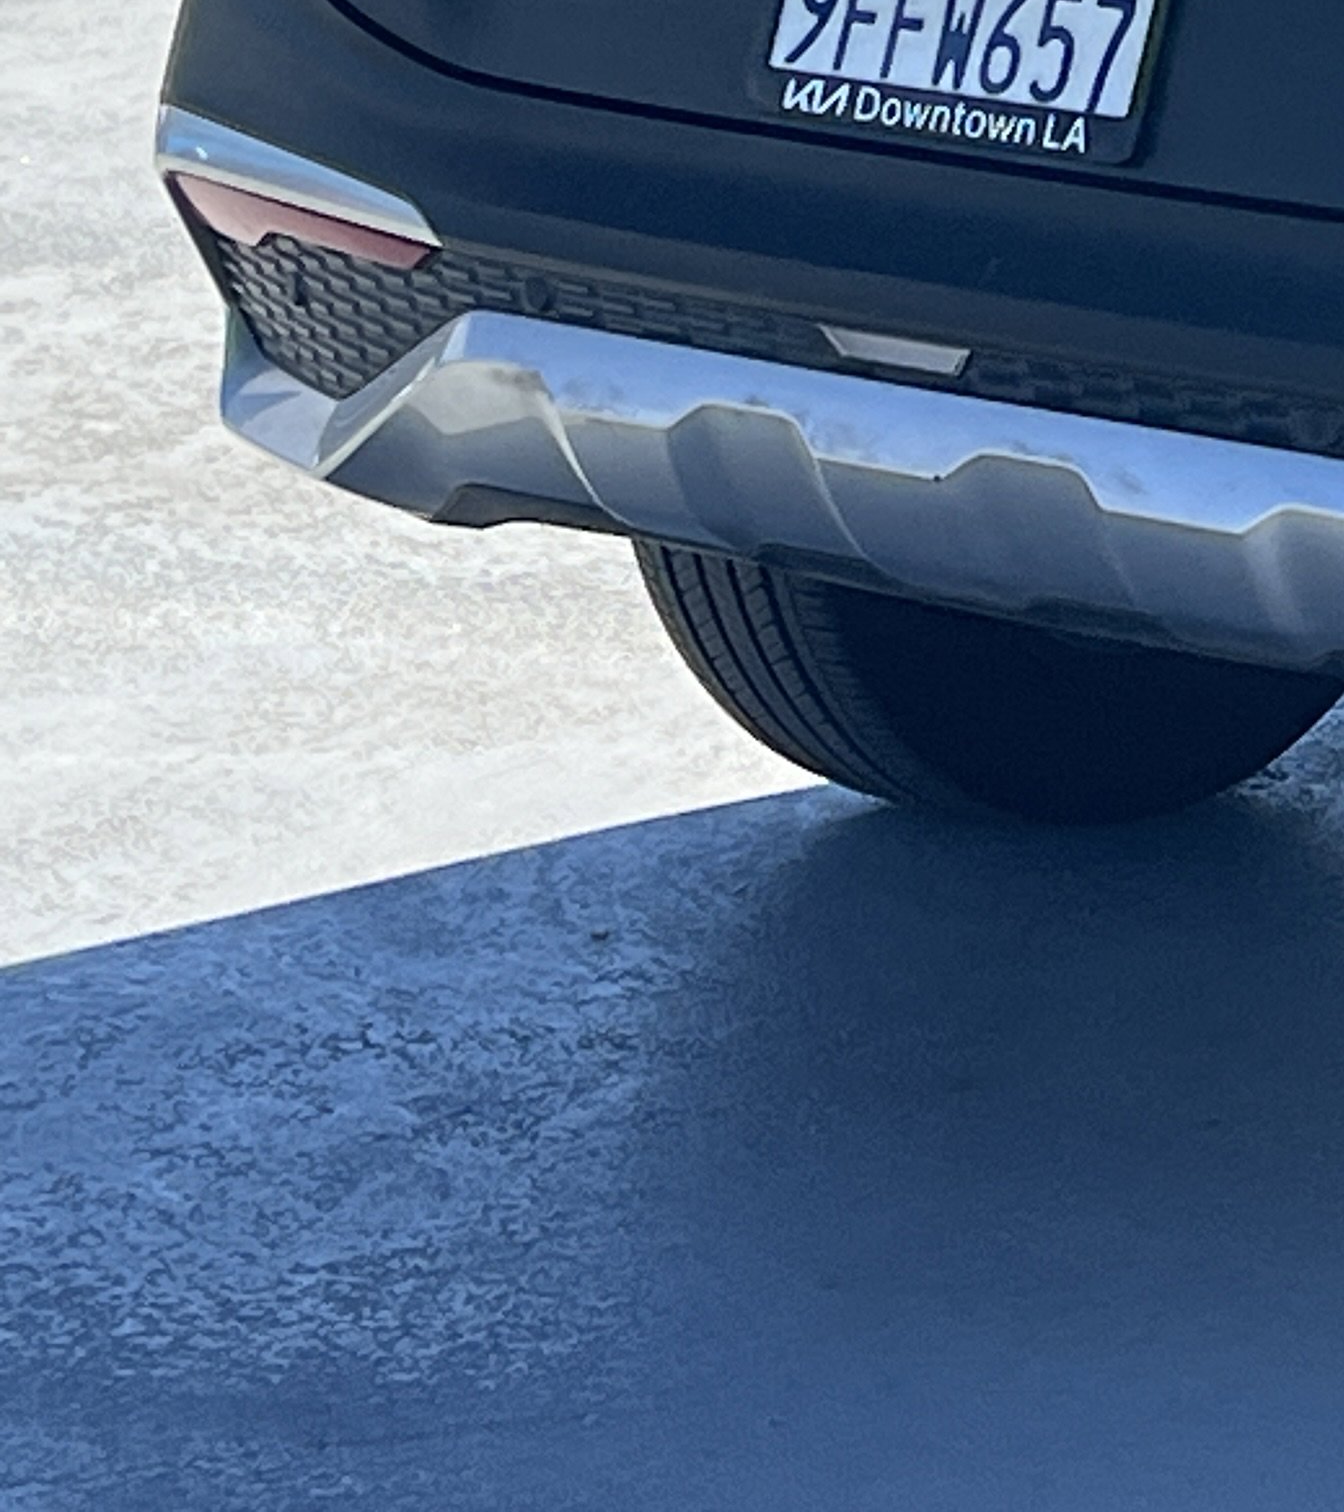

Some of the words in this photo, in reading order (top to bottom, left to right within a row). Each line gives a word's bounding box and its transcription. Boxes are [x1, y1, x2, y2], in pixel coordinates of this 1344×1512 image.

[782, 78, 850, 117] KIA
[853, 87, 1035, 145] Downtown
[1042, 116, 1086, 154] LA
